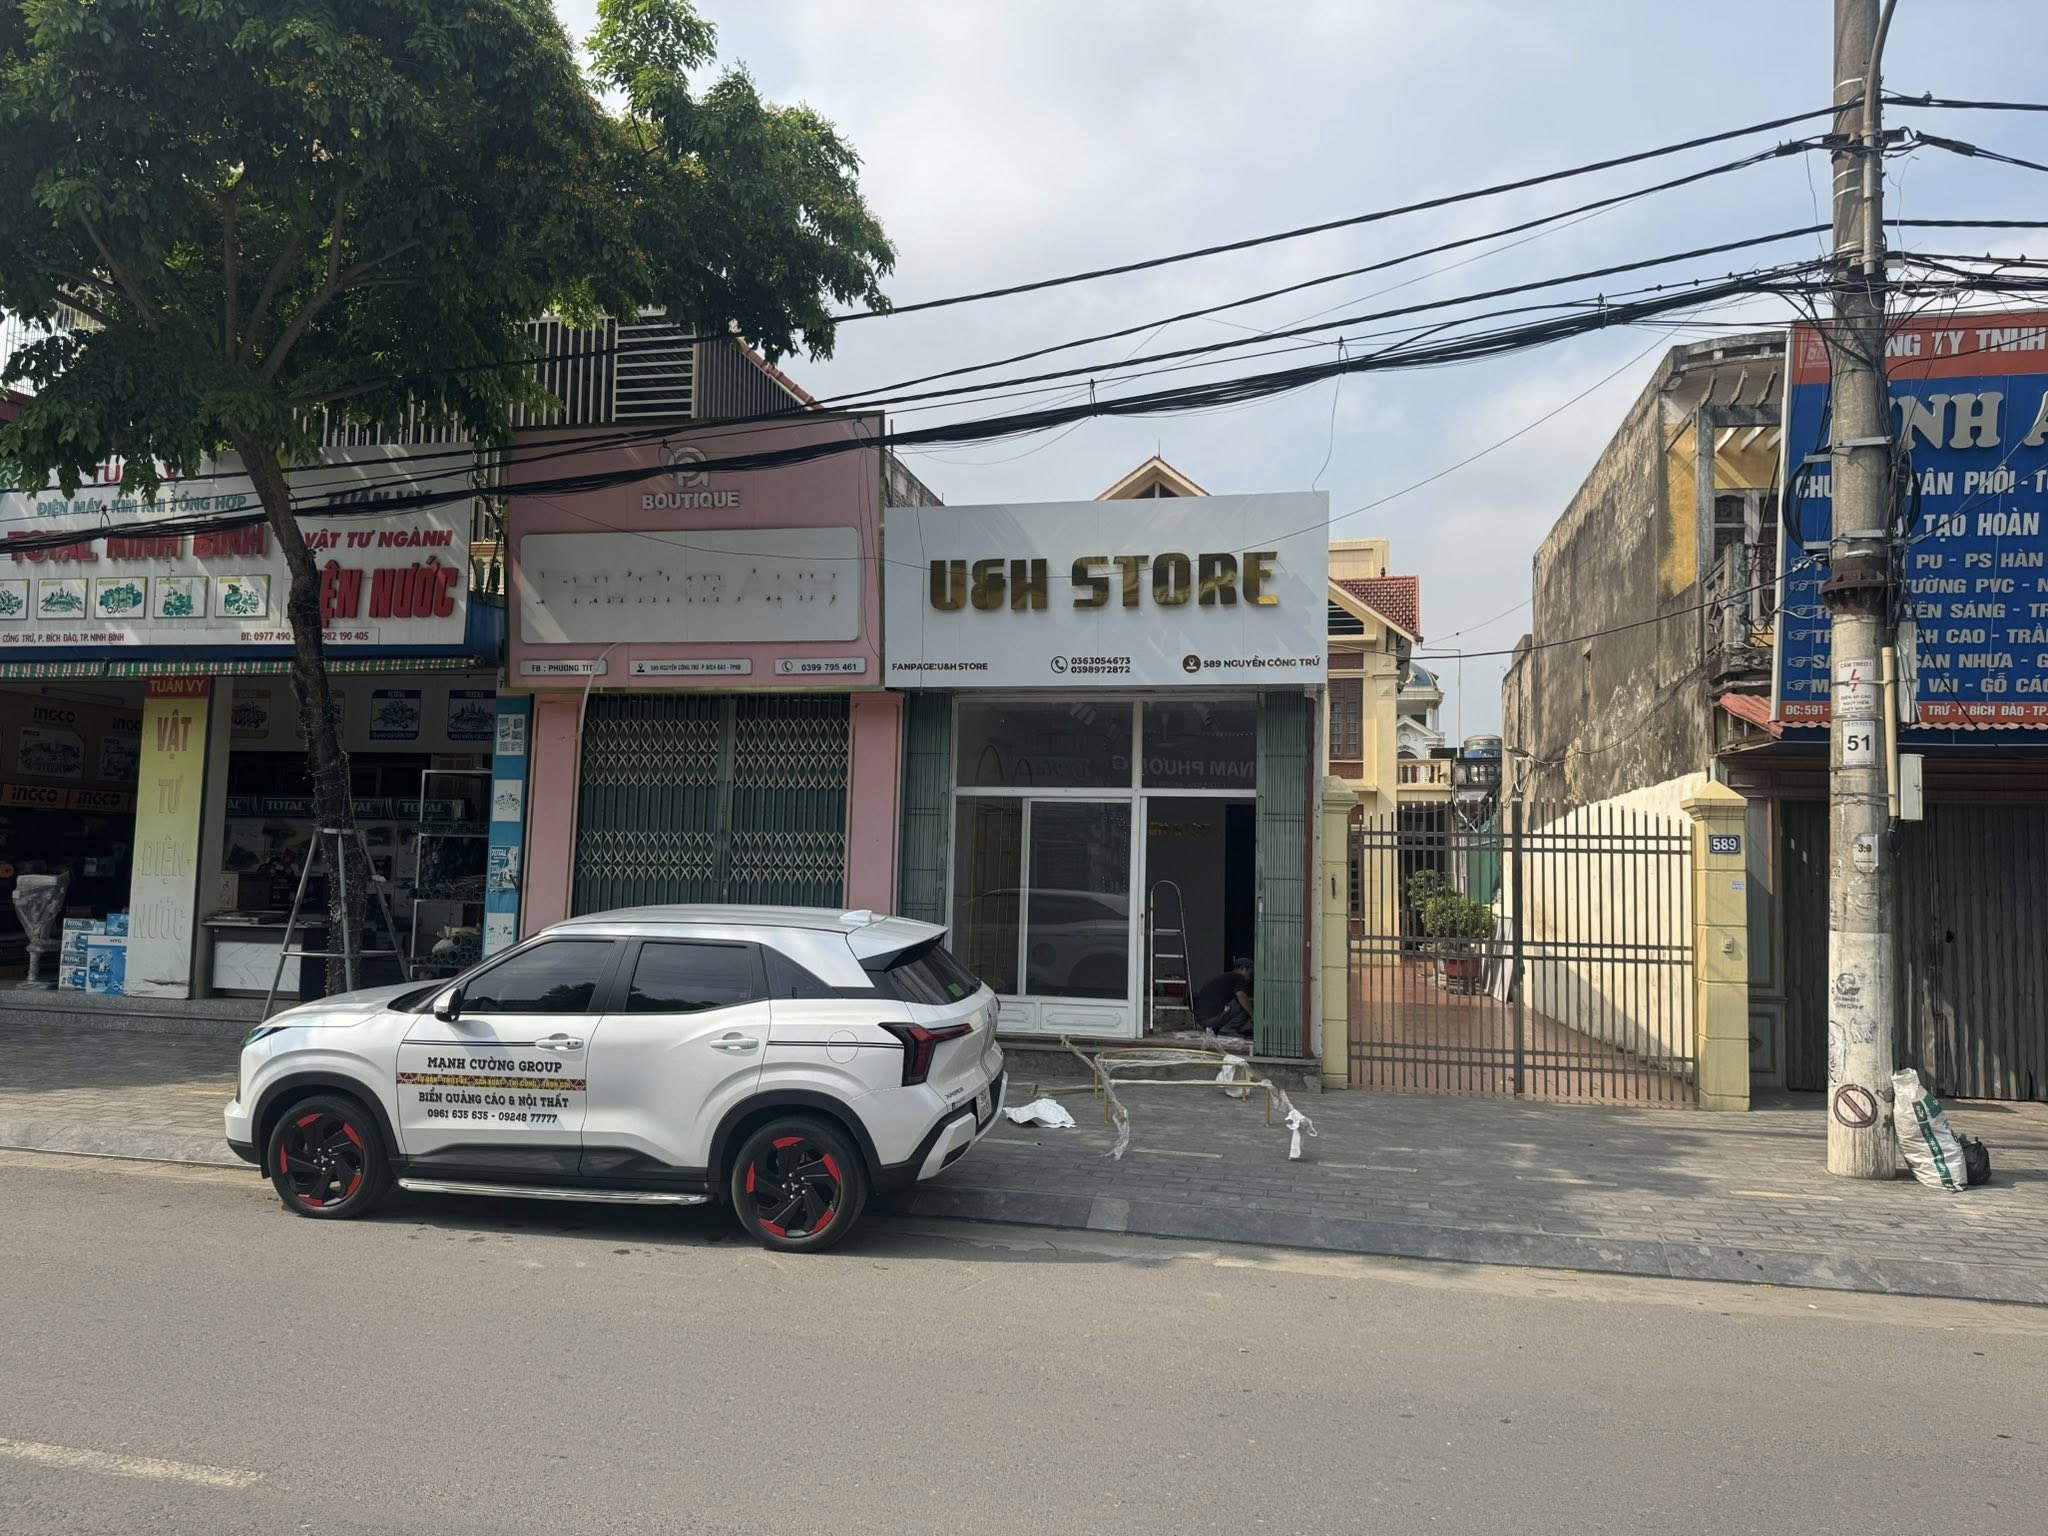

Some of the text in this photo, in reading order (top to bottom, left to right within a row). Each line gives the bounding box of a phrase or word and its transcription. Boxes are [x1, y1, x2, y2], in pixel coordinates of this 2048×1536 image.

[1932, 330, 1967, 355] TY
[1976, 327, 2046, 352] TNHH
[74, 497, 102, 513] MÁY
[111, 499, 137, 513] KIM
[641, 491, 740, 509] BOUTIQUE
[1977, 506, 2040, 537] HOÀN
[304, 526, 453, 552] VẬT TƯ NGÀNH
[1915, 548, 2043, 569] PU PS HÀN
[929, 551, 1279, 611] U&H STORE
[1975, 578, 2013, 593] PVC
[319, 559, 363, 628] ỆN
[369, 555, 459, 618] NƯỚC
[1950, 599, 2005, 618] SÁNG
[90, 633, 106, 641] NINH
[254, 632, 274, 640] 0977
[275, 632, 290, 640] 490
[322, 632, 336, 640] 982
[1946, 628, 1986, 644] CAO
[842, 663, 857, 671] 461
[958, 662, 988, 670] STORE
[1071, 656, 1131, 665] 0363054673
[1203, 660, 1221, 668] 589
[1267, 656, 1297, 667] CÔNG
[1071, 665, 1131, 674] 0398972872
[186, 680, 204, 692] VY
[1847, 734, 1870, 752] 51
[1712, 838, 1737, 850] 589
[427, 1056, 562, 1073] MẠNH CƯỜNG GROUP
[418, 1086, 443, 1103] BIỂN
[445, 1091, 482, 1106] QUẢNG
[484, 1092, 506, 1106] CÁO
[518, 1093, 538, 1110] NỘI
[540, 1093, 569, 1108] THẤT
[452, 1110, 469, 1120] 635
[472, 1111, 489, 1120] 635
[530, 1113, 558, 1123] 77777
